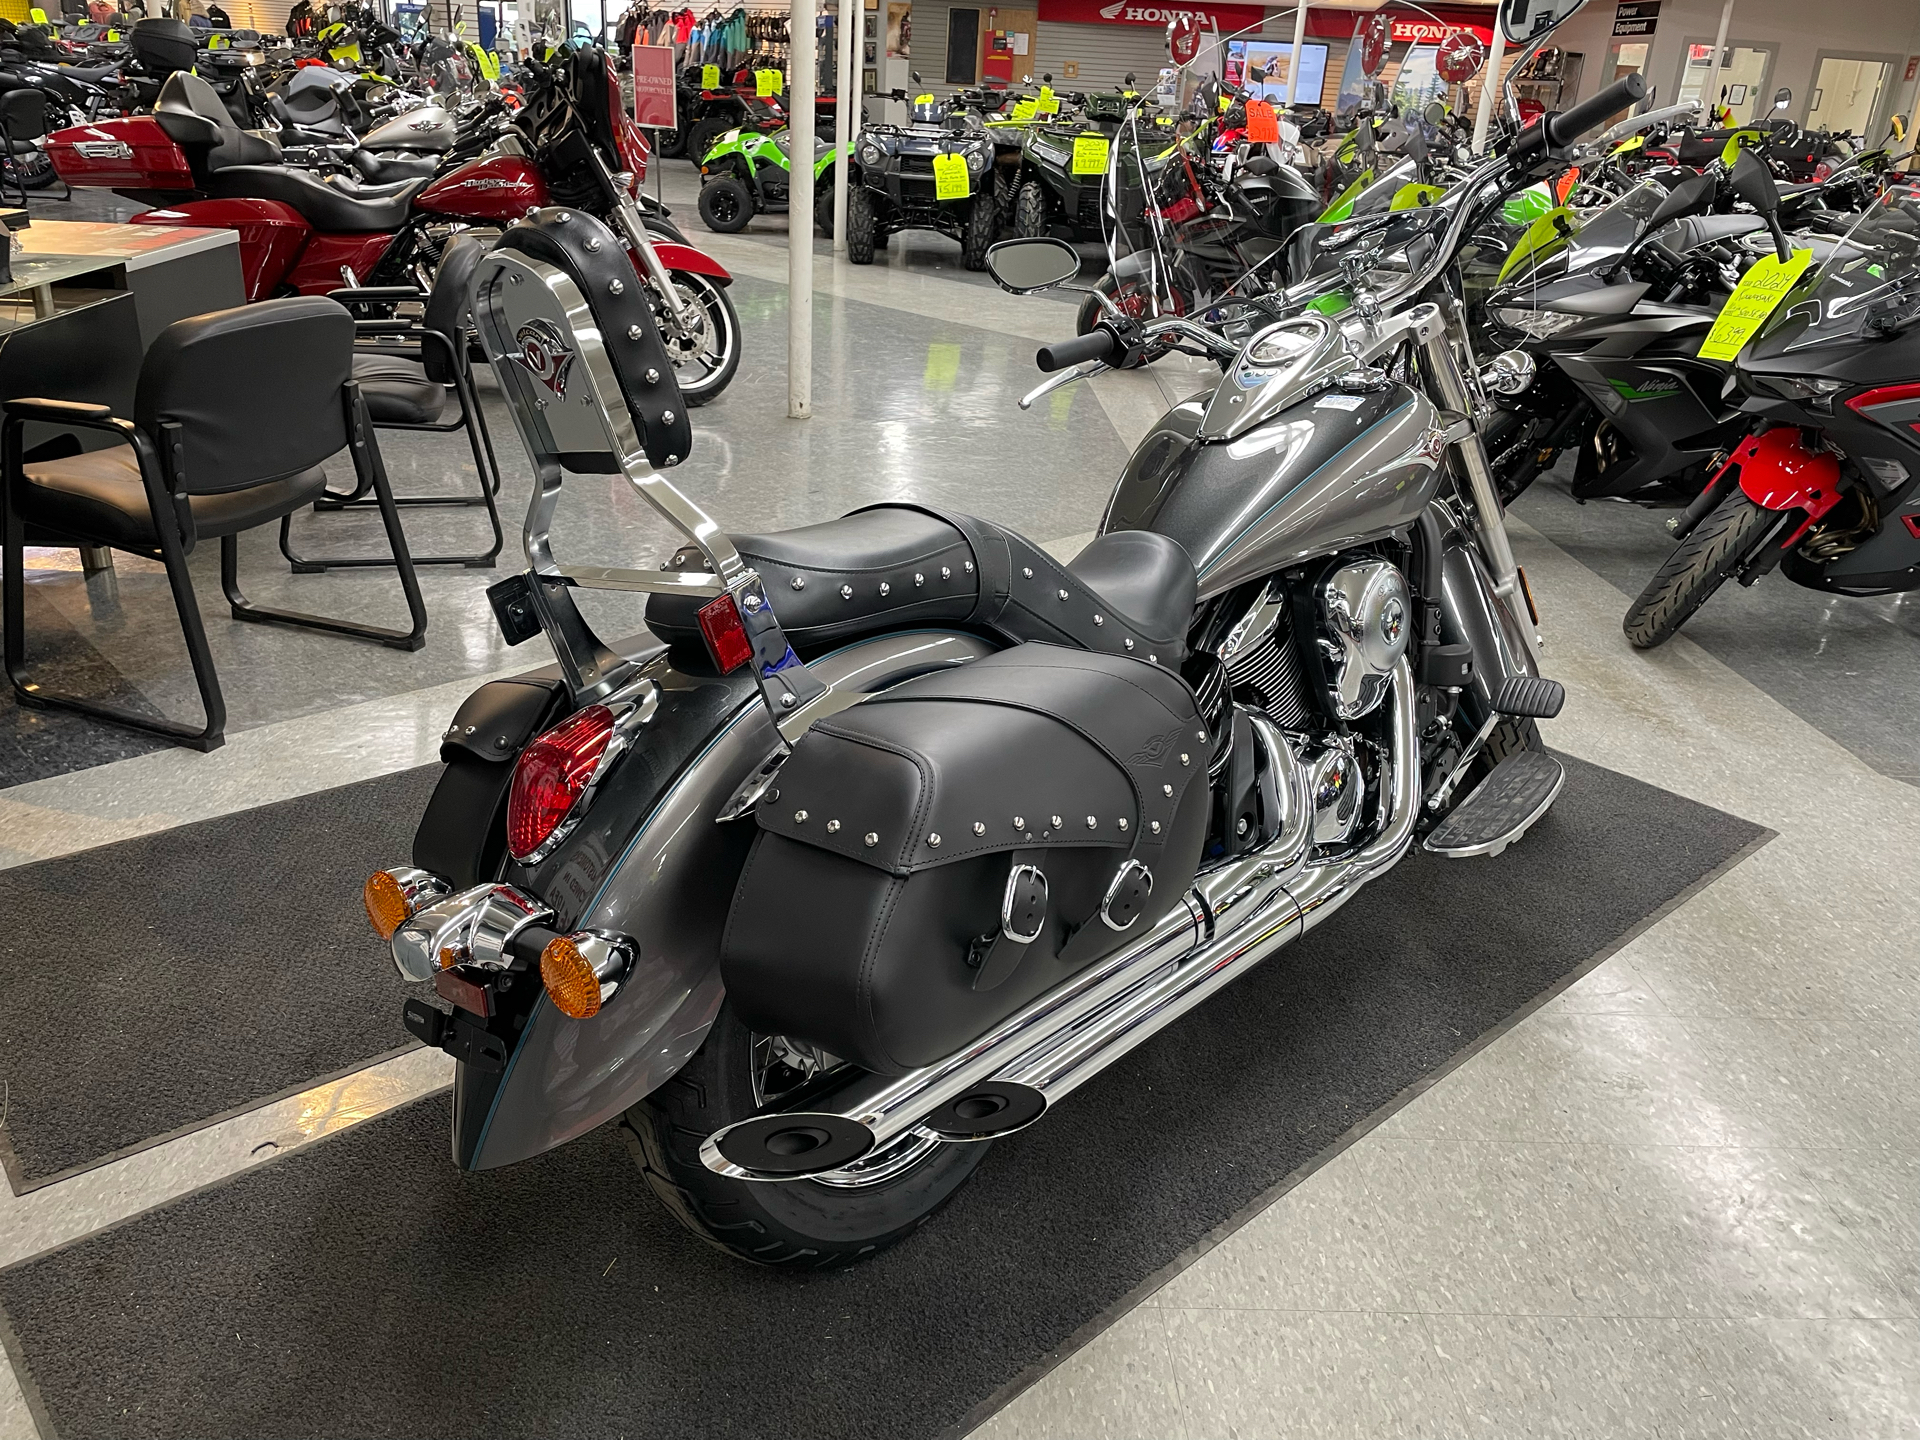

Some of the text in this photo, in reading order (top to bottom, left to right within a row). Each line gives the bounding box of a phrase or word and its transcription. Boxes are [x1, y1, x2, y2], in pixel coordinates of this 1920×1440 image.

[1618, 6, 1639, 17] Power
[1615, 21, 1647, 35] Equipment
[636, 75, 673, 86] PRE-OWNED
[636, 86, 674, 95] MOTORCYCLES
[1248, 107, 1274, 119] SALE
[1752, 269, 1796, 290] 2024
[1636, 378, 1679, 393] Ninja
